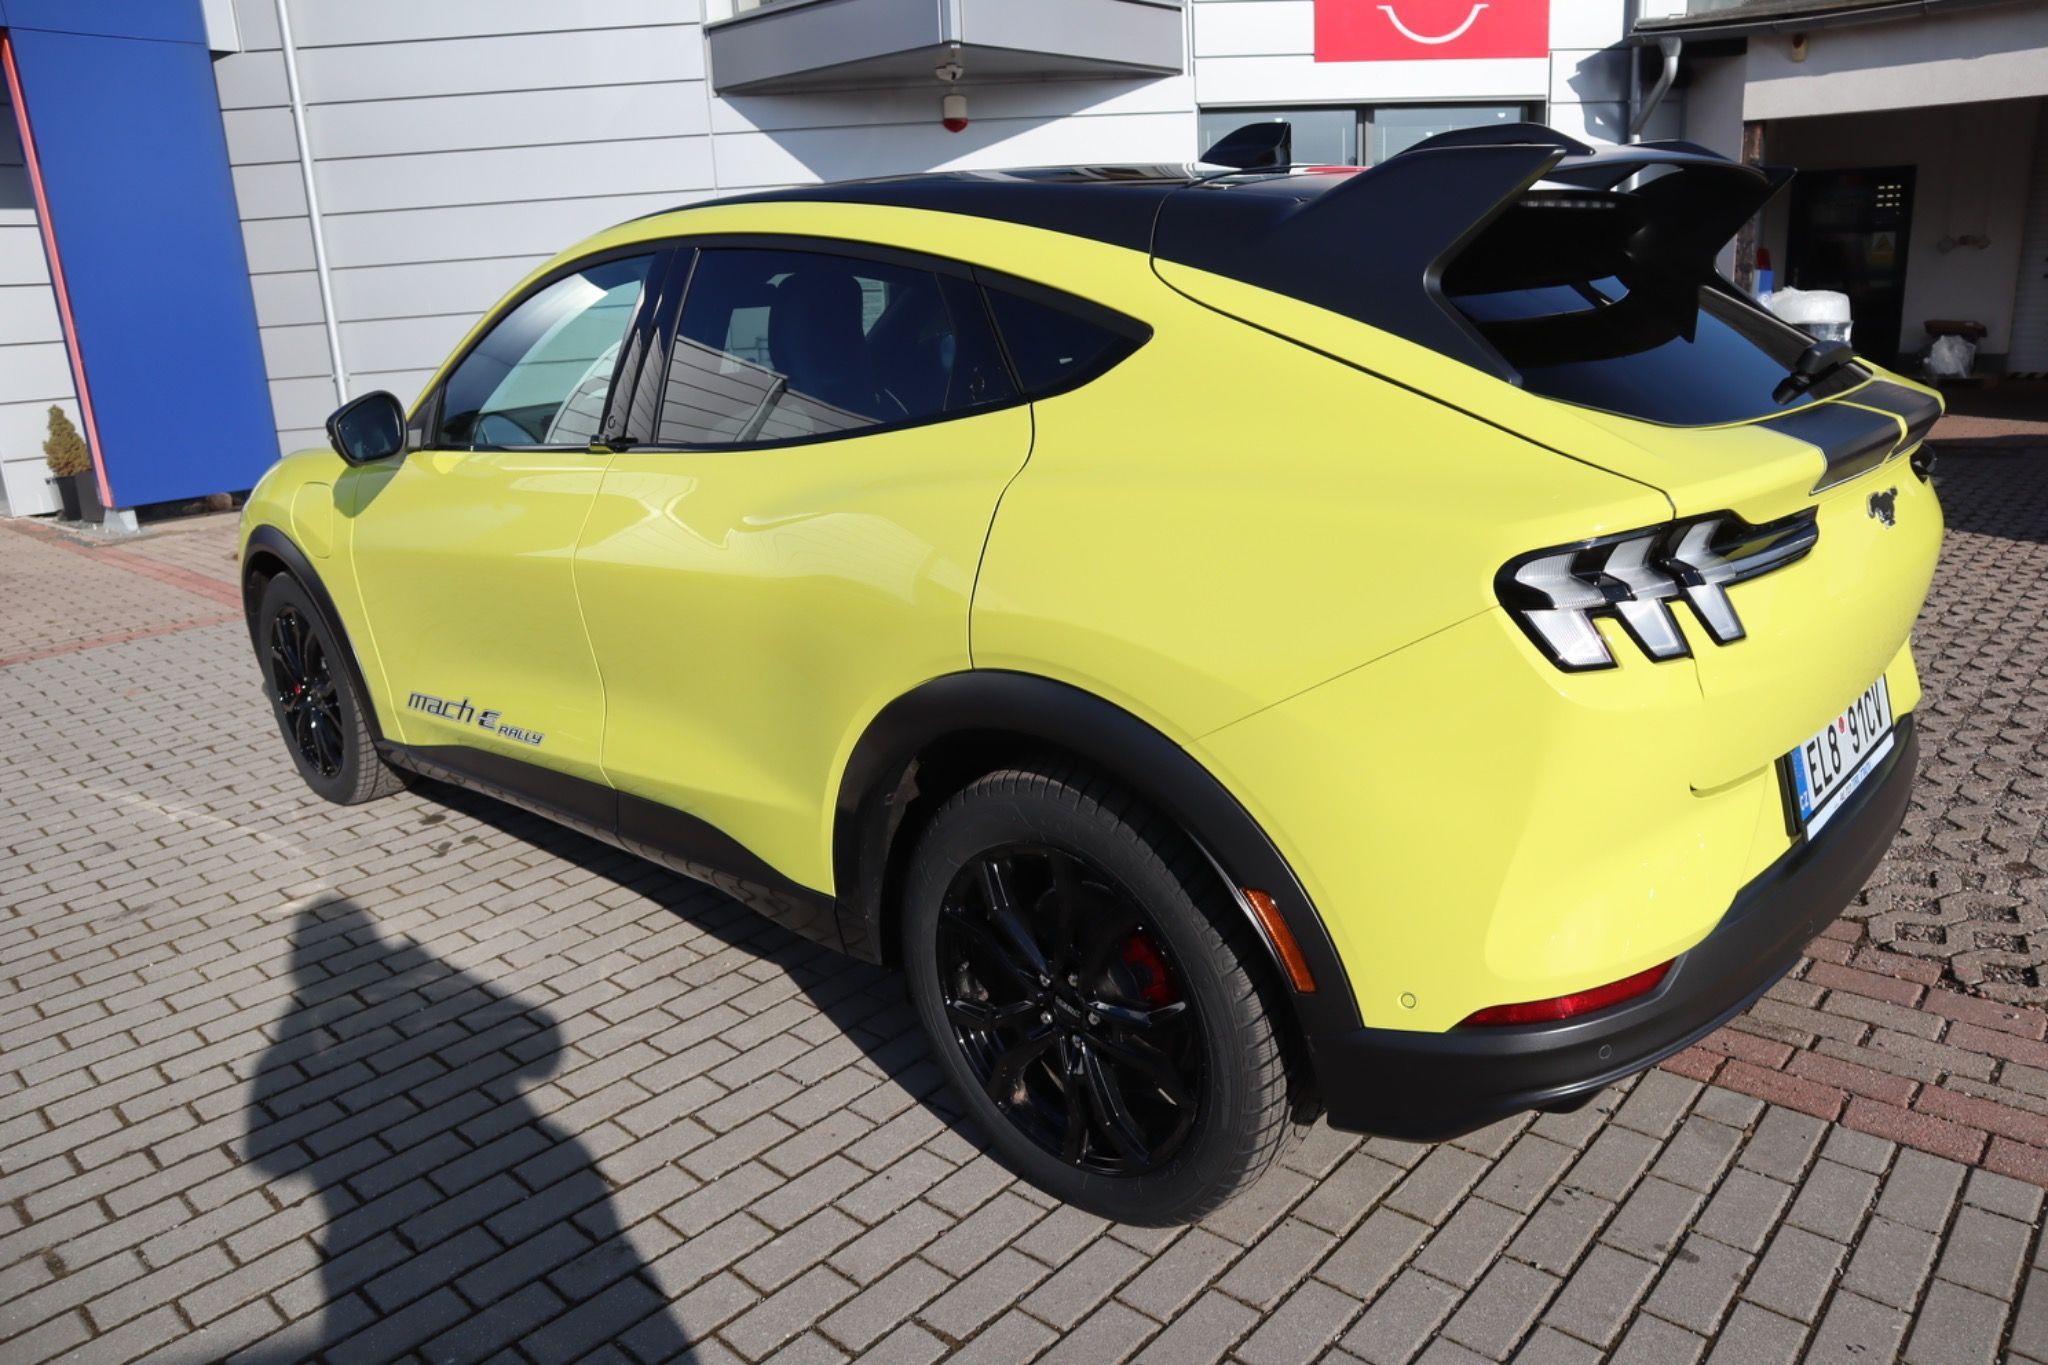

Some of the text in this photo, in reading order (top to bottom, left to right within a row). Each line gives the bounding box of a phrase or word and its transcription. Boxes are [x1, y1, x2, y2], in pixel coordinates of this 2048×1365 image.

[497, 725, 545, 746] RALLY
[1806, 724, 1841, 798] EL8
[1847, 681, 1883, 754] 91CV
